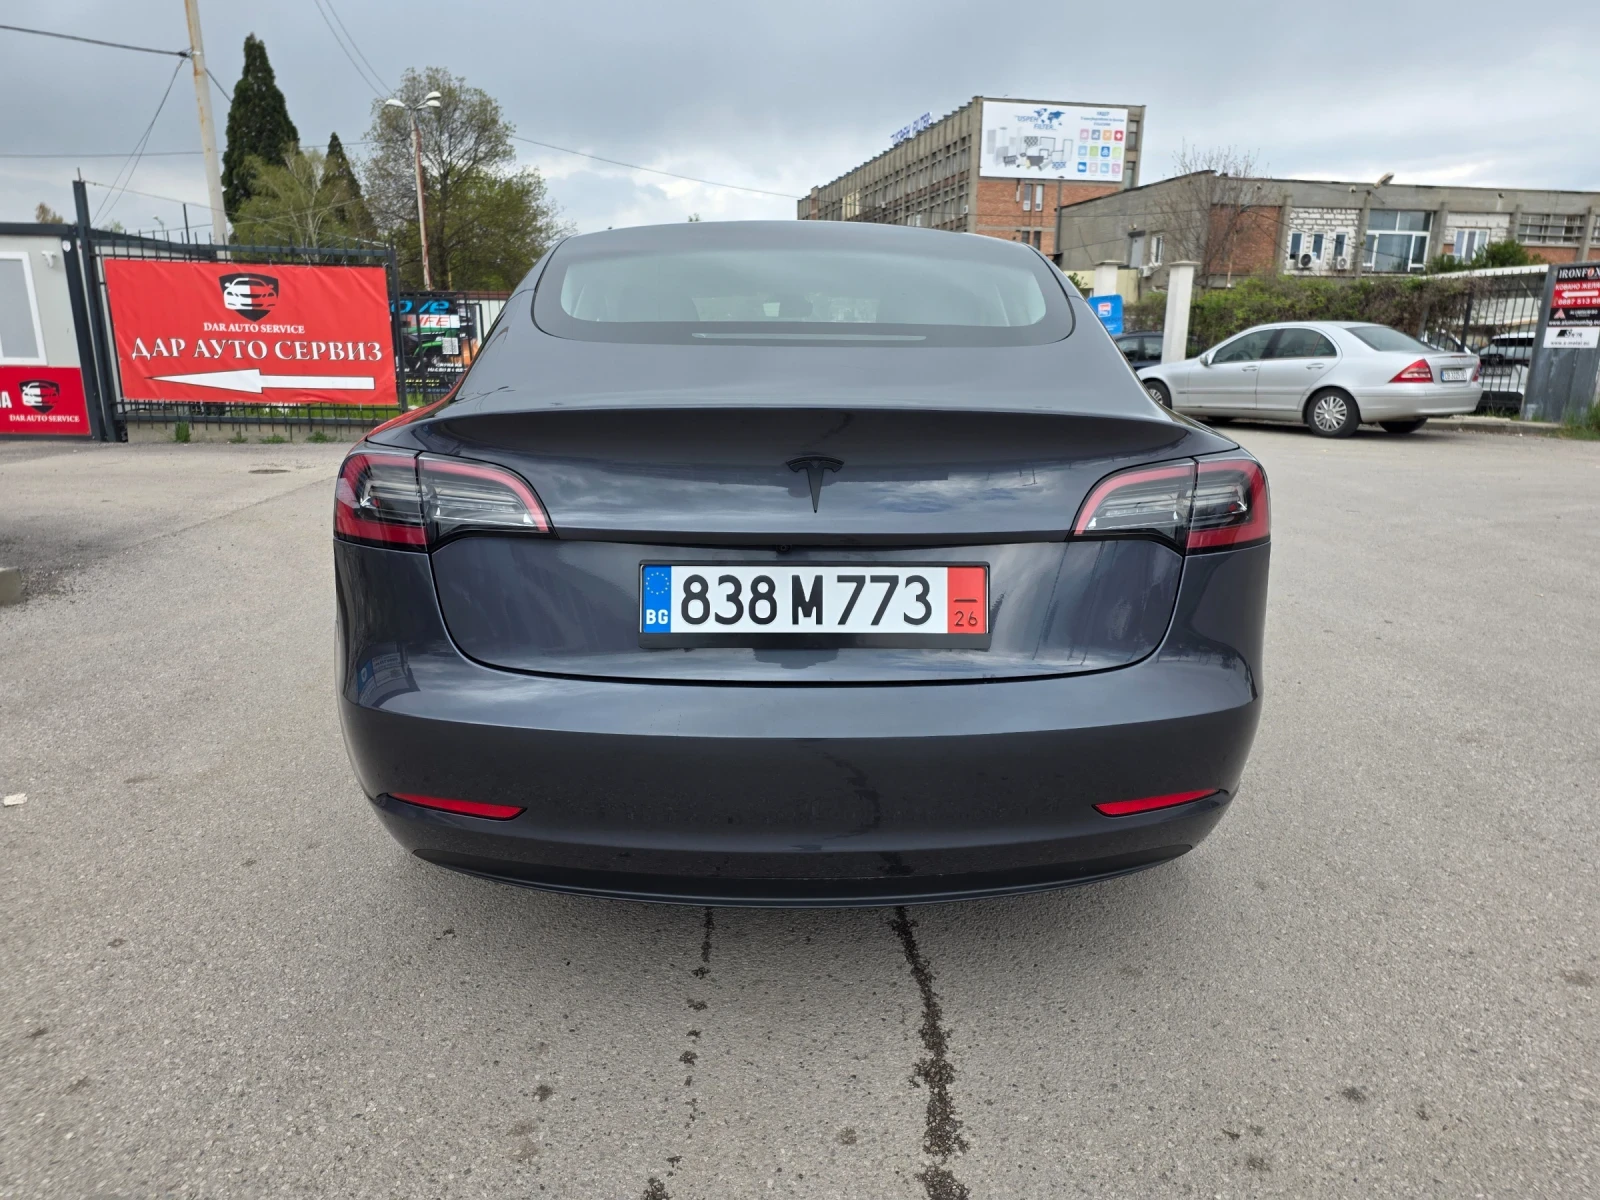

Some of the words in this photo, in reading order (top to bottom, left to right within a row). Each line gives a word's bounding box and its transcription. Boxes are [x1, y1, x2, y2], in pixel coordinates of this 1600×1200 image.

[204, 322, 226, 332] DAR
[228, 323, 259, 333] AUTO
[260, 324, 305, 334] SERVICE
[132, 337, 185, 361] ДАР
[194, 338, 267, 359] АУТО
[274, 340, 382, 361] СЕРВИЗ
[9, 414, 26, 422] DAR
[27, 414, 47, 422] AUTO
[681, 574, 777, 625] 838
[791, 574, 824, 626] M
[836, 574, 933, 626] 773
[645, 609, 669, 625] BG
[953, 611, 978, 627] 26
